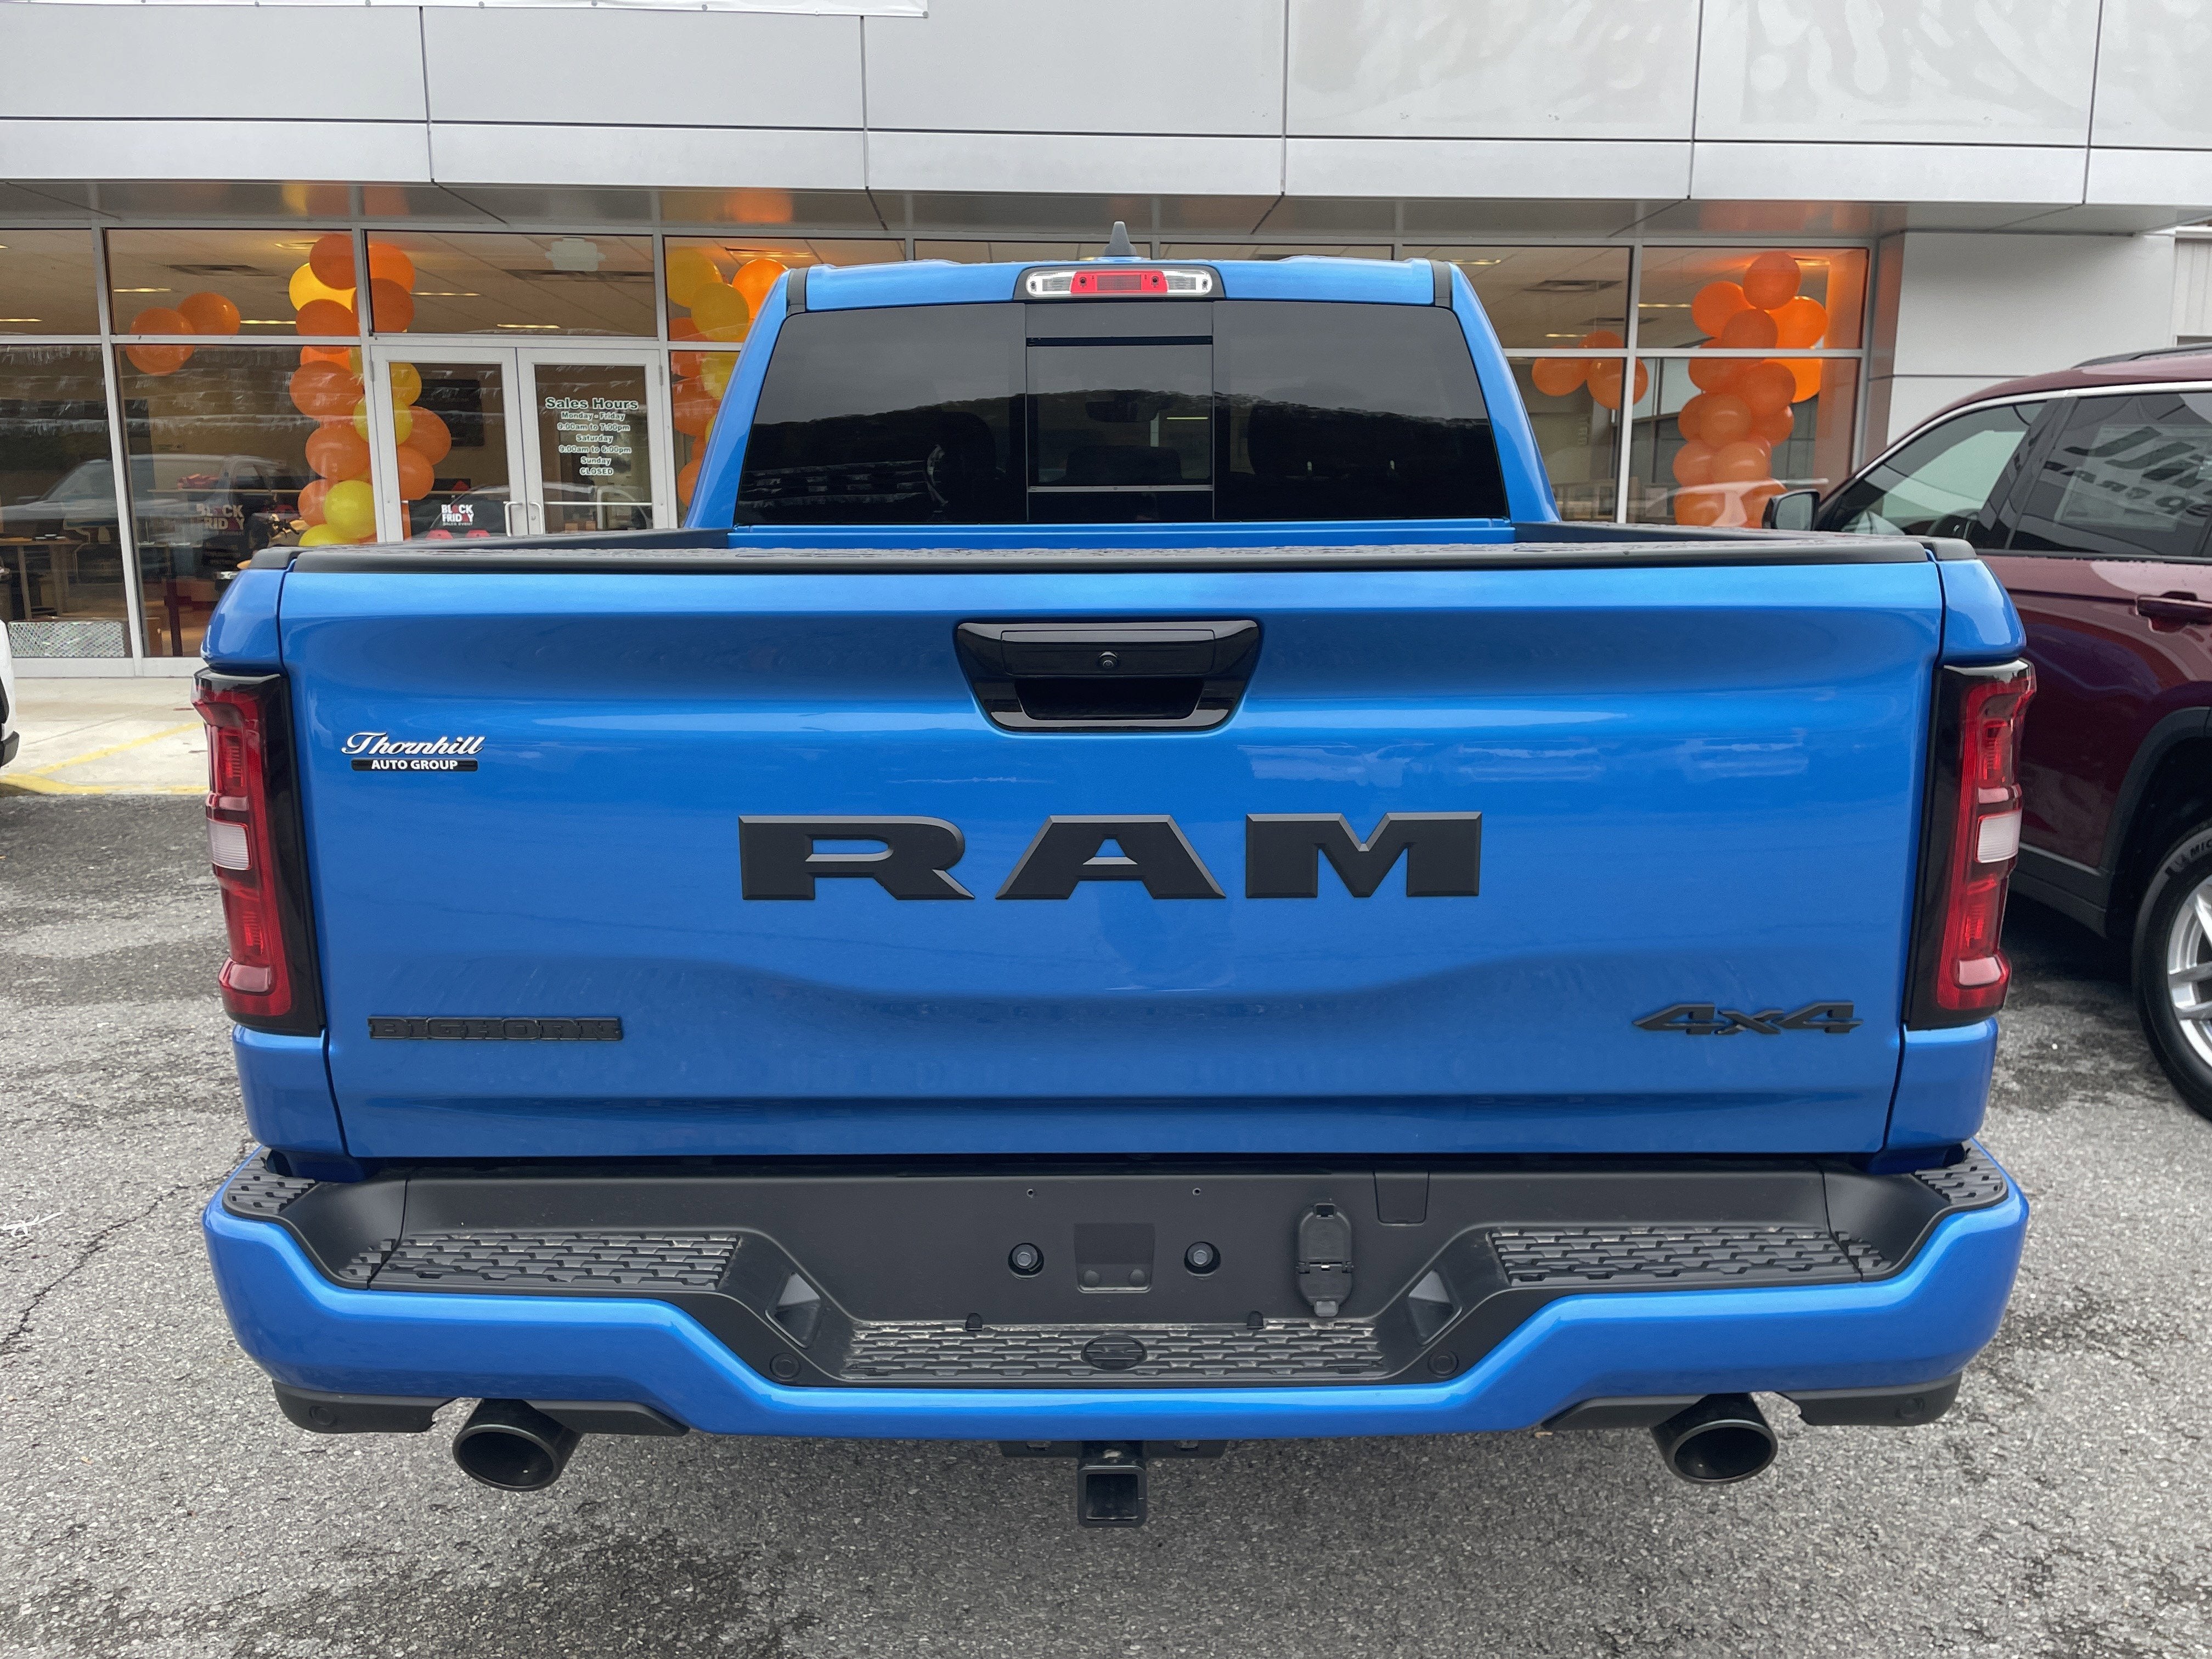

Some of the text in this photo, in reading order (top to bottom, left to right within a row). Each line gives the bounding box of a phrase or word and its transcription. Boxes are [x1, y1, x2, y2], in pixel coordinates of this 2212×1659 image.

[545, 397, 639, 410] Sales Hours
[561, 411, 594, 421] Monday
[599, 411, 626, 421] Friday
[557, 422, 588, 431] 9:00am
[600, 423, 630, 432] 7:00pm
[575, 434, 613, 443] Saturday
[558, 445, 632, 455] 9:00am to 6:00pm
[580, 456, 612, 465] Sunday
[579, 467, 614, 476] CLOSED
[341, 731, 487, 755] Thornhill
[371, 759, 459, 770] AUTO GROUP
[738, 812, 1482, 900] RAM
